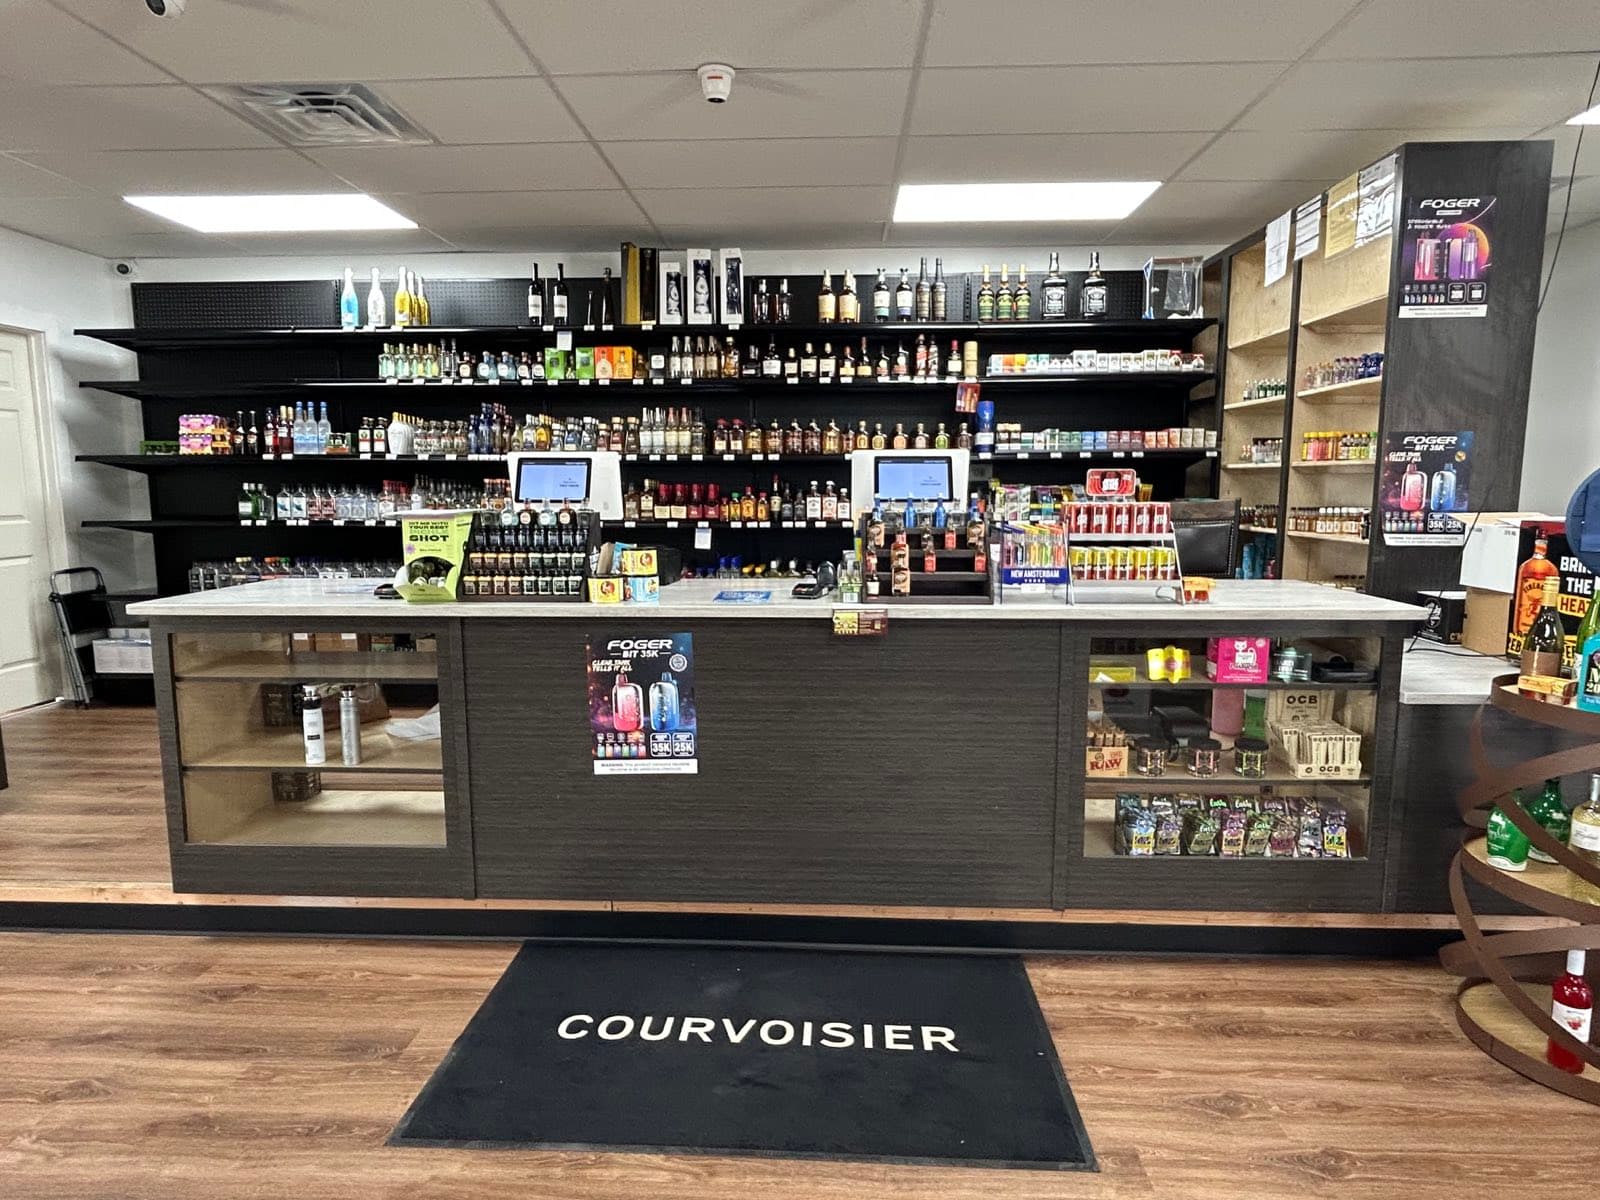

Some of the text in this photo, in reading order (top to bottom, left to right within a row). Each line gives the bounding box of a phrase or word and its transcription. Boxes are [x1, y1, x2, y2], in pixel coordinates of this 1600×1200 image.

[1420, 198, 1481, 209] FOGER
[1403, 436, 1458, 445] FOGER
[1428, 521, 1444, 529] 35K
[1446, 521, 1462, 529] 25K
[409, 534, 450, 542] SHOT
[1010, 569, 1060, 578] NEW AMSTERDAM
[1566, 577, 1592, 595] THE
[607, 639, 674, 650] FOGER
[622, 650, 659, 658] BIT 35K
[1287, 695, 1318, 704] OCB
[652, 743, 670, 752] 35K
[674, 743, 692, 752] 25K
[1089, 757, 1123, 771] RAW
[556, 1014, 960, 1052] COURVOISIER
